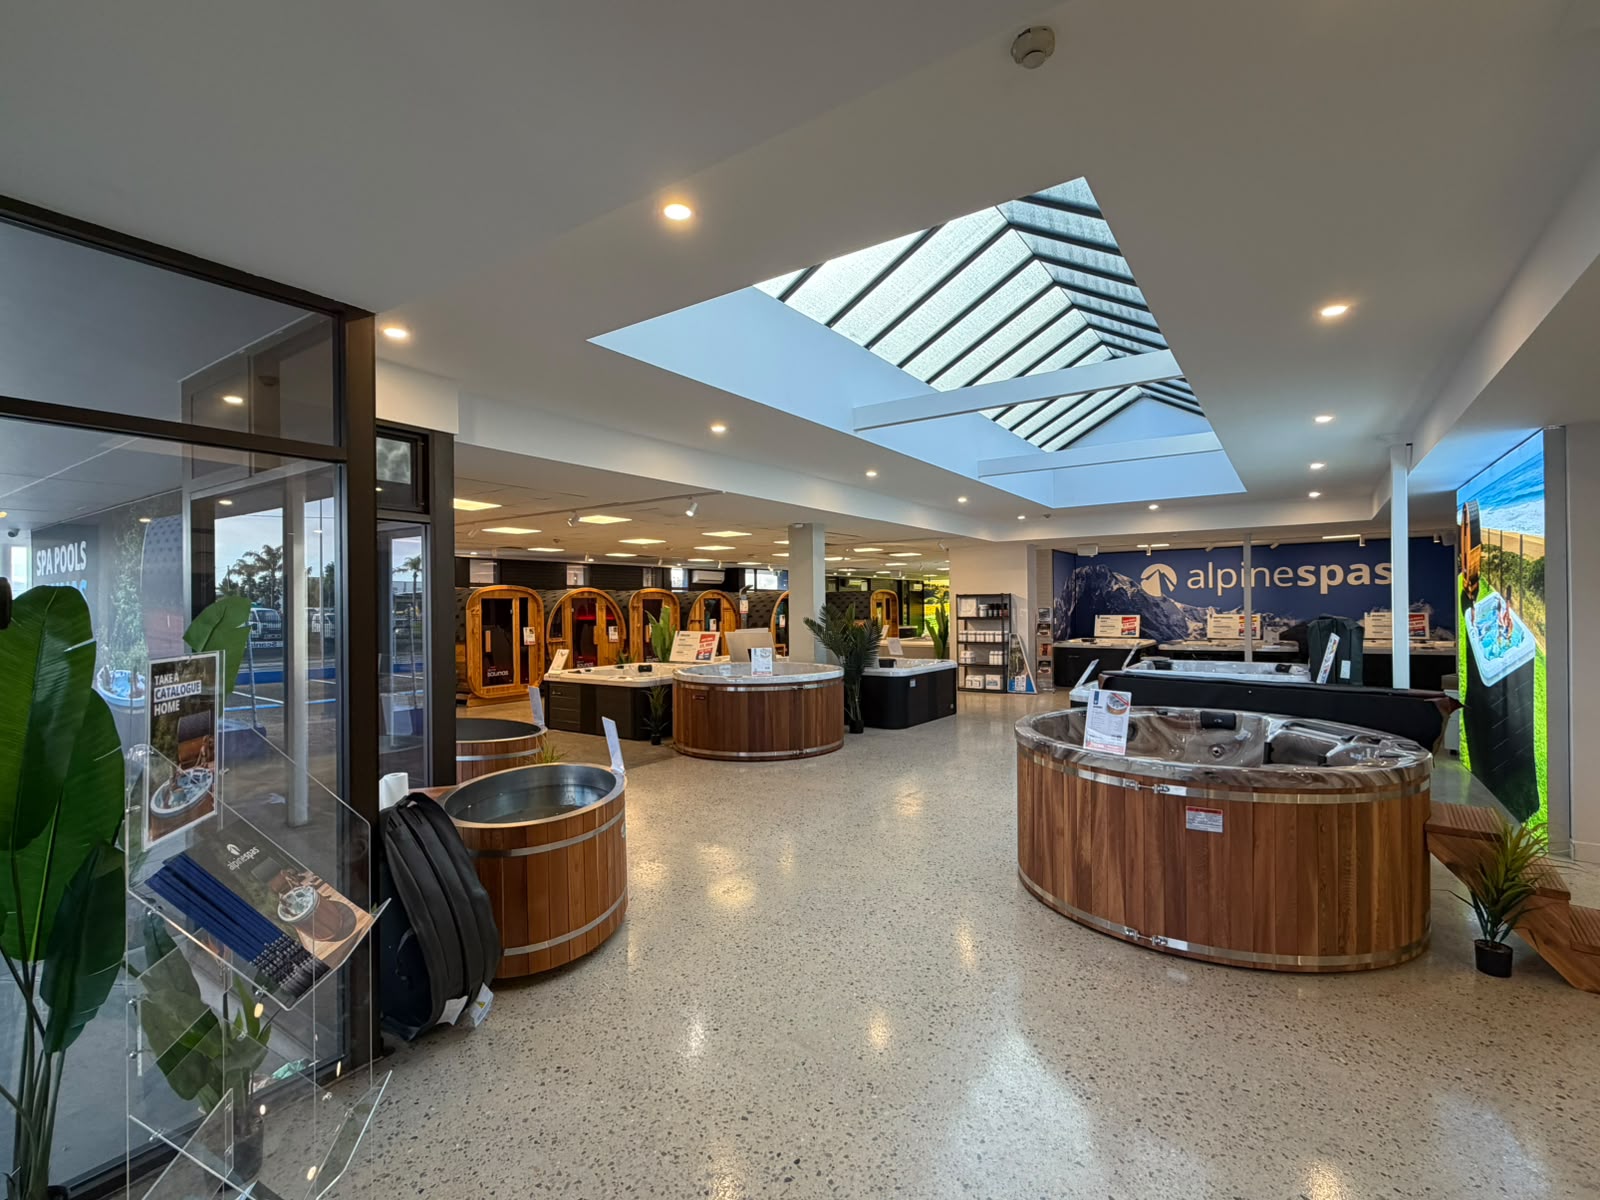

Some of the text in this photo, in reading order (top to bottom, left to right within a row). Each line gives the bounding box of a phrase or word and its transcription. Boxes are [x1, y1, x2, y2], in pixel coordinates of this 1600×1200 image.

[36, 540, 87, 577] SPA POOLS
[1187, 562, 1392, 597] alpinespas
[154, 671, 180, 686] TAKE A
[155, 681, 201, 700] CATALOGUE
[154, 699, 180, 717] HOME
